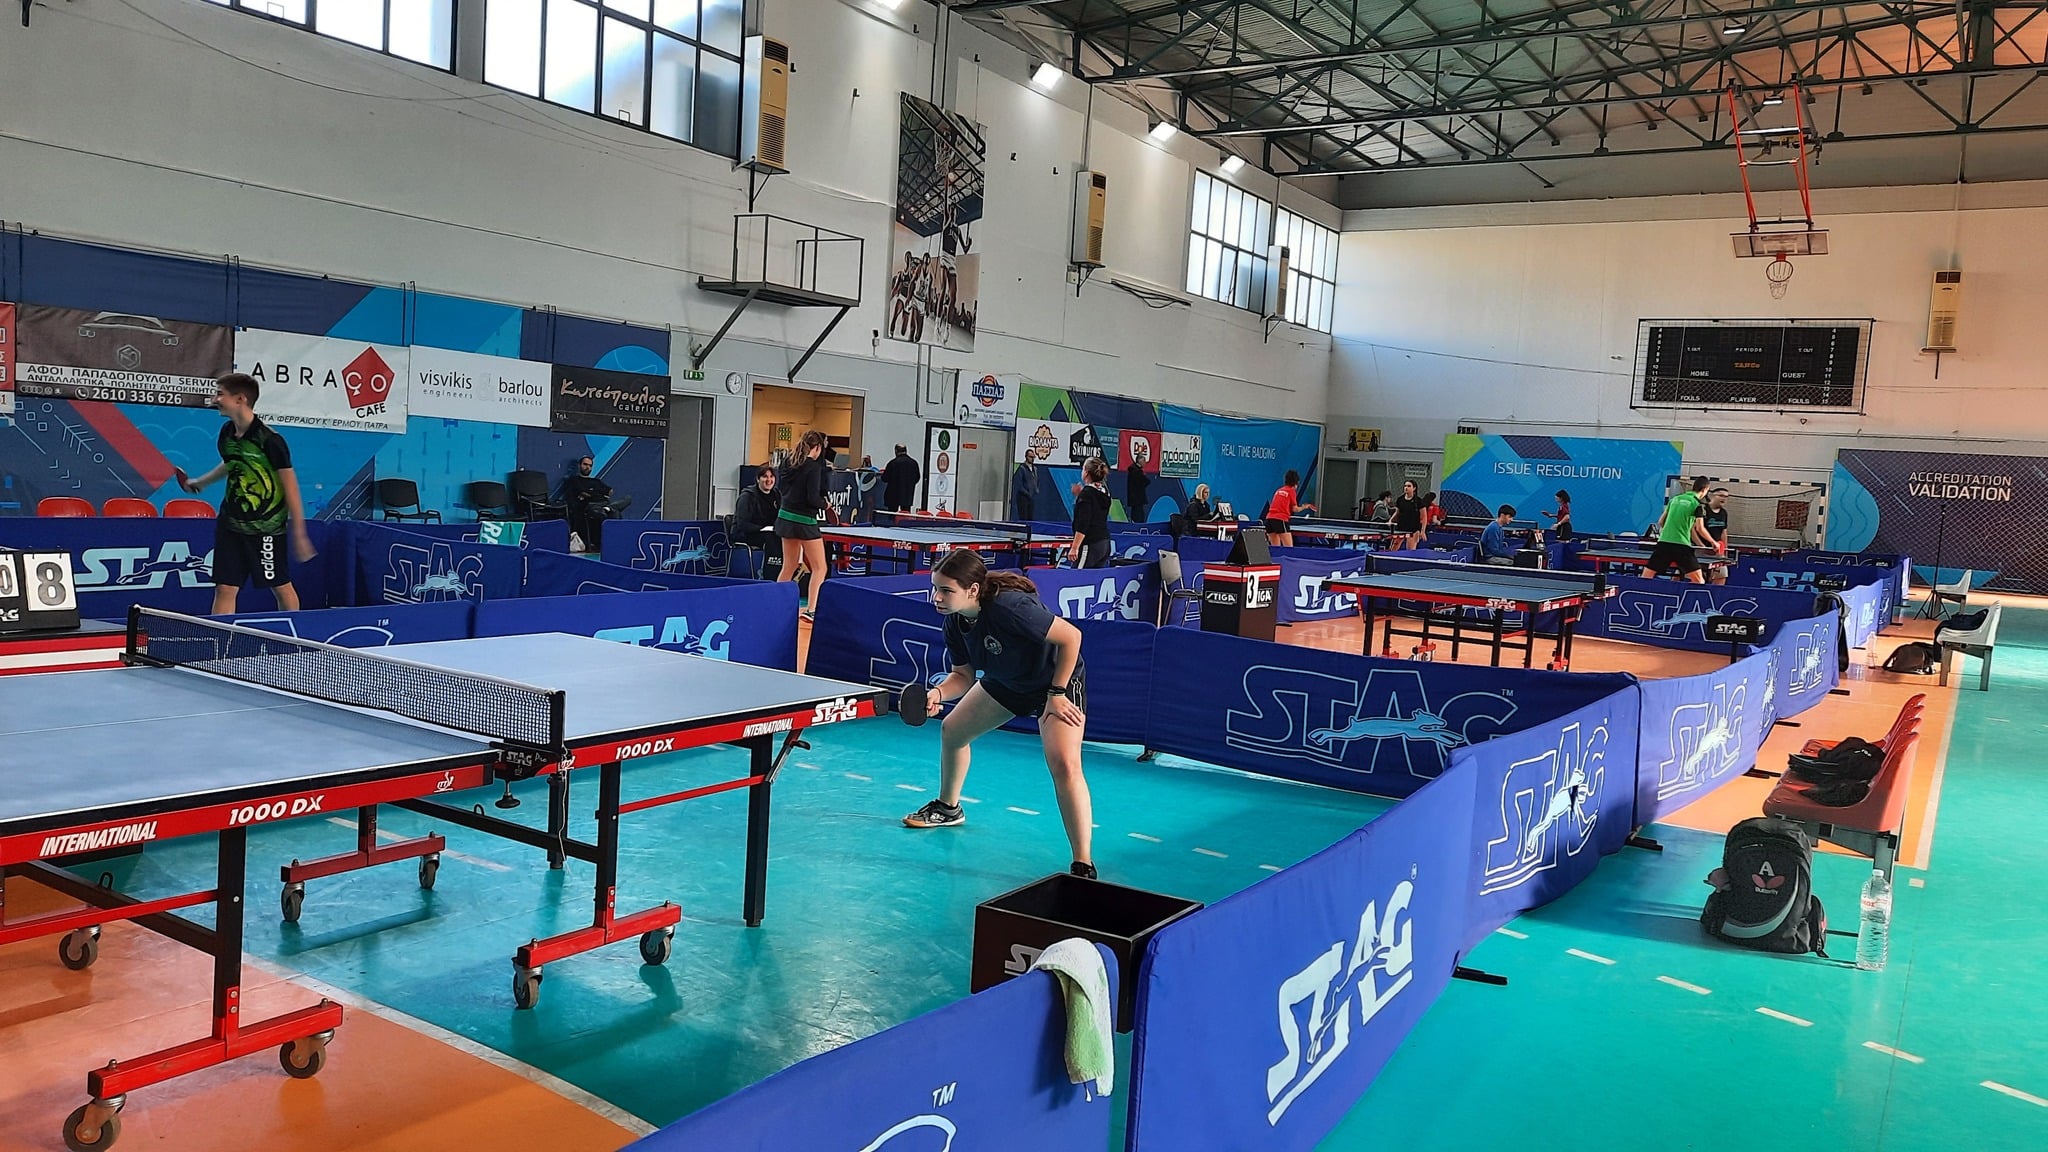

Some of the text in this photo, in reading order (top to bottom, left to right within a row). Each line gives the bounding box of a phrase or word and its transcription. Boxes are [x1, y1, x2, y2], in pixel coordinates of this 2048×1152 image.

[27, 365, 217, 388] ΑΦΟΙ ΠΑΠΑΔΟΠΟΥΛΟΙ SERVIC
[27, 374, 104, 386] ΑΝΤΑΛΛΑΚΤΙΚΑ
[159, 384, 217, 395] ΑΥΤΟΚΙΝΗΤΟ
[420, 370, 472, 390] visvikis
[499, 377, 543, 397] barlou
[92, 387, 182, 405] 2610 336 626
[423, 388, 473, 400] engineers
[560, 378, 666, 408] Κωτσόπουλος
[972, 384, 1004, 398] ΠΑΣΣΙΑΣ
[356, 402, 386, 419] CAFE
[499, 396, 542, 407] architects
[618, 403, 661, 415] catering
[257, 413, 274, 422] ΗΓΑ
[1029, 436, 1059, 449] ΒΙΟΛΑΝΤΑ
[1072, 441, 1102, 457] Skiouros
[1221, 443, 1276, 460] REAL TIME BADGING
[1494, 462, 1622, 480] ISSUE RESOLUTION
[1908, 471, 2012, 486] ACCREDITATION
[1908, 482, 2011, 501] VALIDATION
[74, 541, 216, 592] STA
[260, 535, 274, 580] adidas
[36, 561, 67, 607] 8
[1248, 574, 1255, 604] 3
[1760, 571, 1819, 593] STA
[1058, 577, 1141, 620] STAG
[1206, 592, 1236, 602] STIGA
[1485, 598, 1516, 610] STAG
[1715, 623, 1748, 637] STAG
[812, 696, 858, 726] STAG
[742, 716, 794, 738] INTERNATIONAL
[615, 737, 675, 760] 1000 DX
[229, 795, 326, 826] 1000 DX
[40, 820, 157, 857] INTERNATIONAL
[1758, 861, 1775, 877] A
[1266, 879, 1415, 1127] STAG
